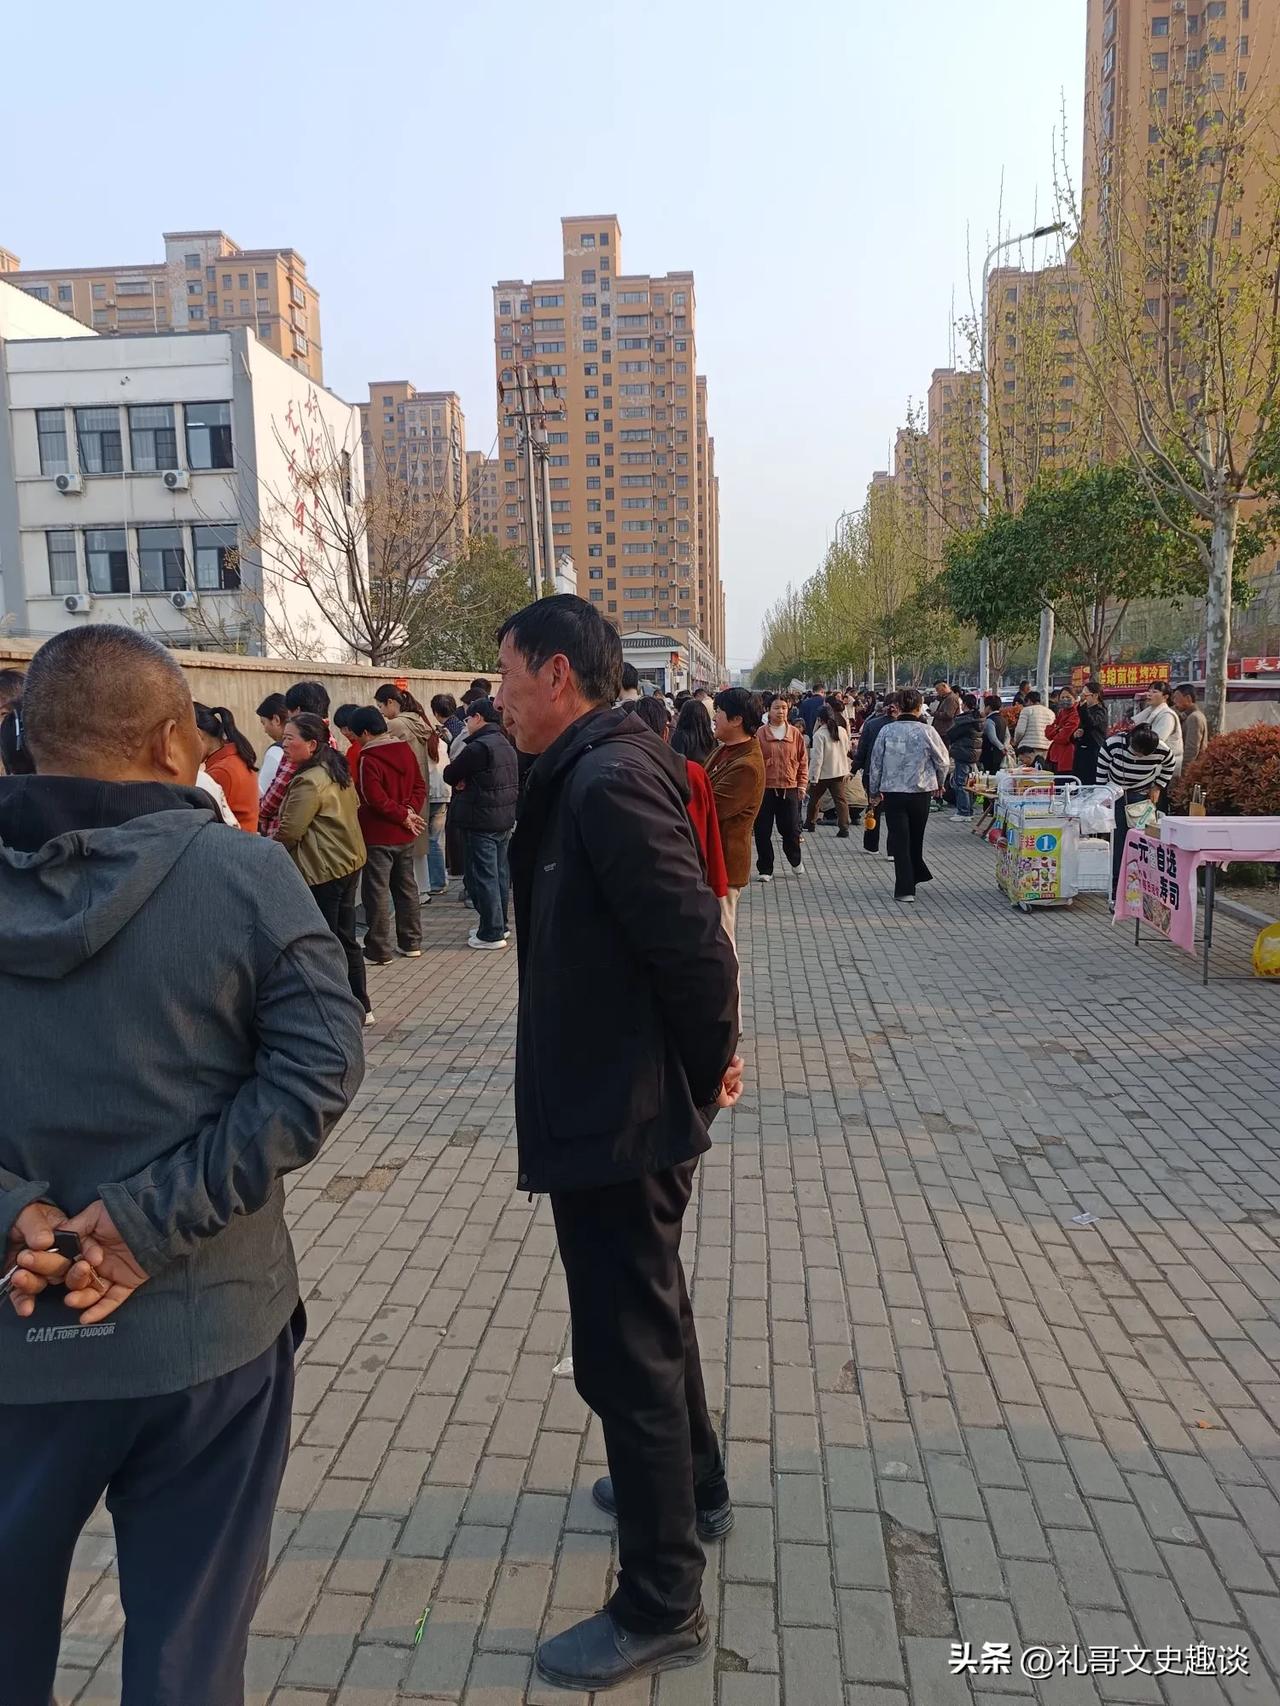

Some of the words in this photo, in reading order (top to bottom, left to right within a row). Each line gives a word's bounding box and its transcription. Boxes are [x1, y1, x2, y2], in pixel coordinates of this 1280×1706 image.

[1139, 665, 1168, 679] 烤冷面
[1160, 876, 1179, 910] 寿司
